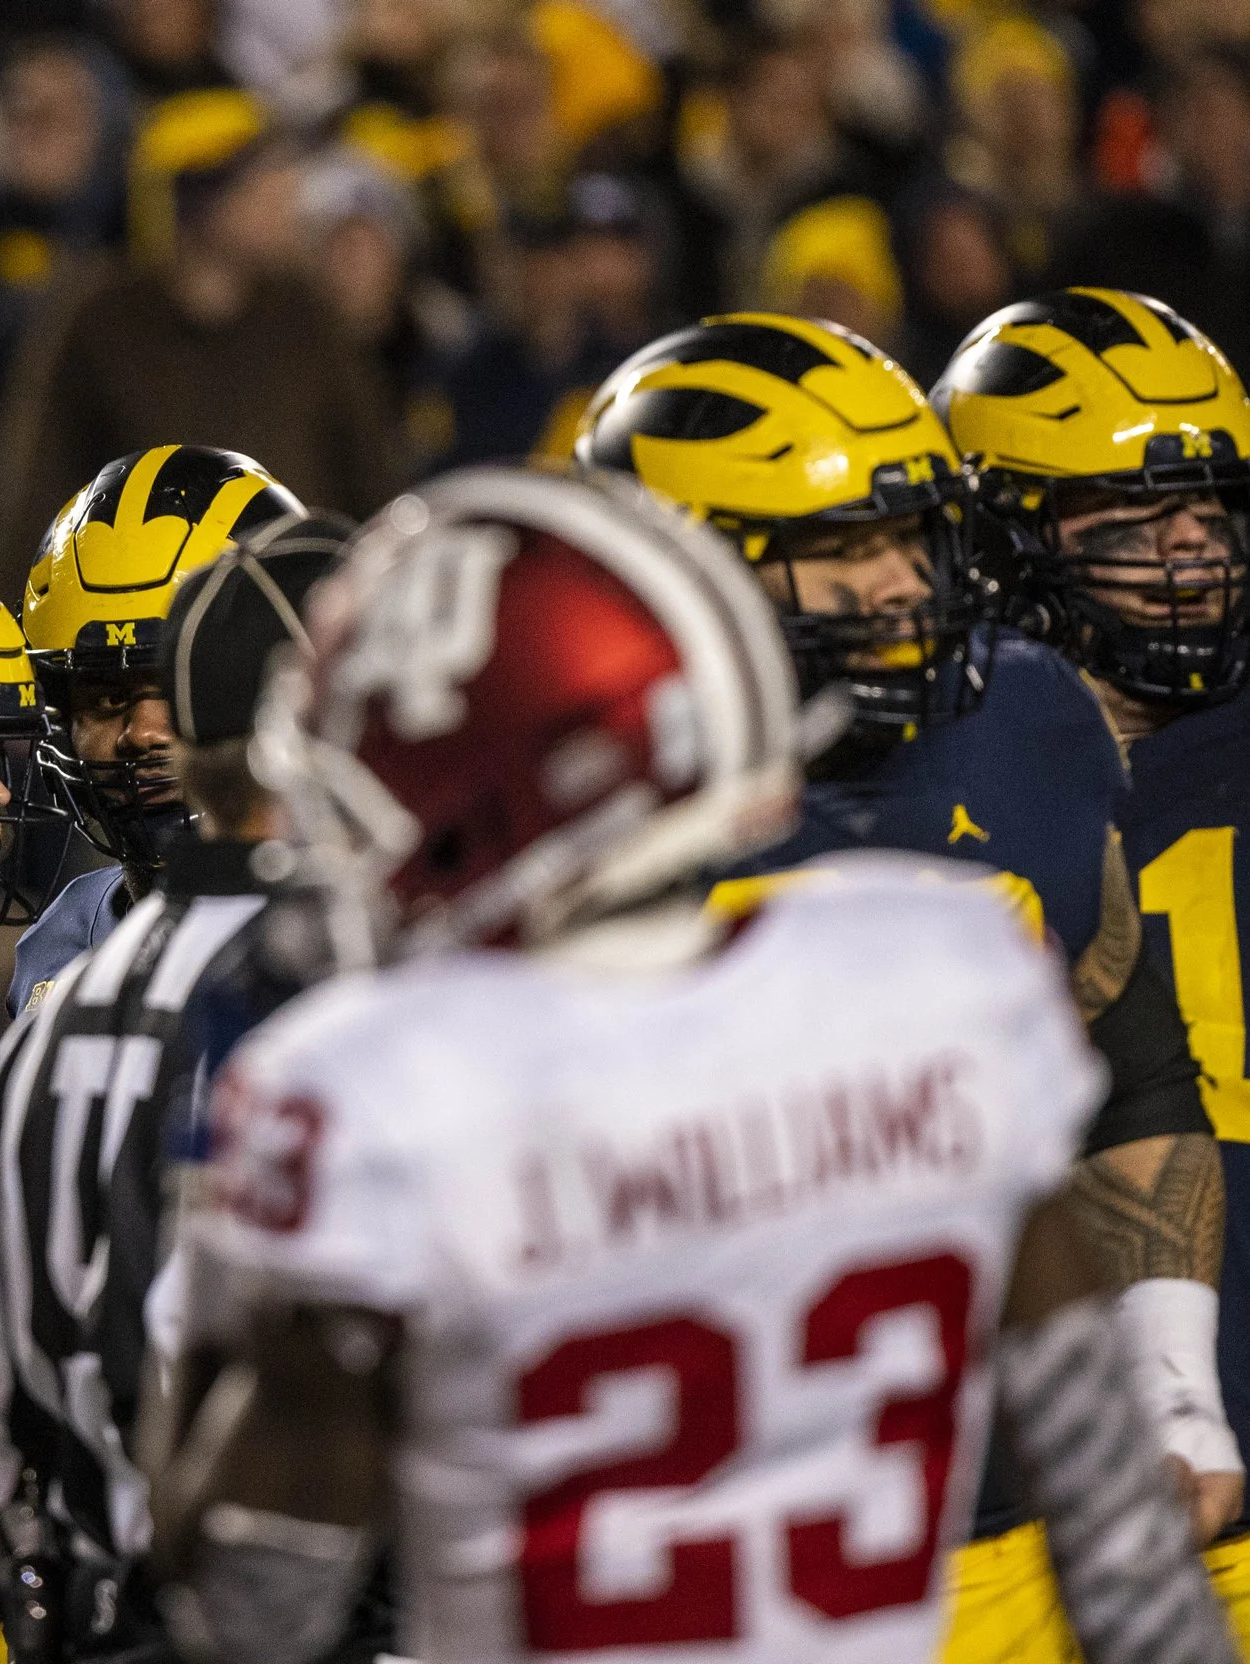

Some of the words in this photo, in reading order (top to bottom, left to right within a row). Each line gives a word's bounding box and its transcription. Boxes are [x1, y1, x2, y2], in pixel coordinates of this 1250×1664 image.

[105, 622, 136, 646] M
[18, 684, 36, 707] M
[518, 1246, 972, 1654] 23
